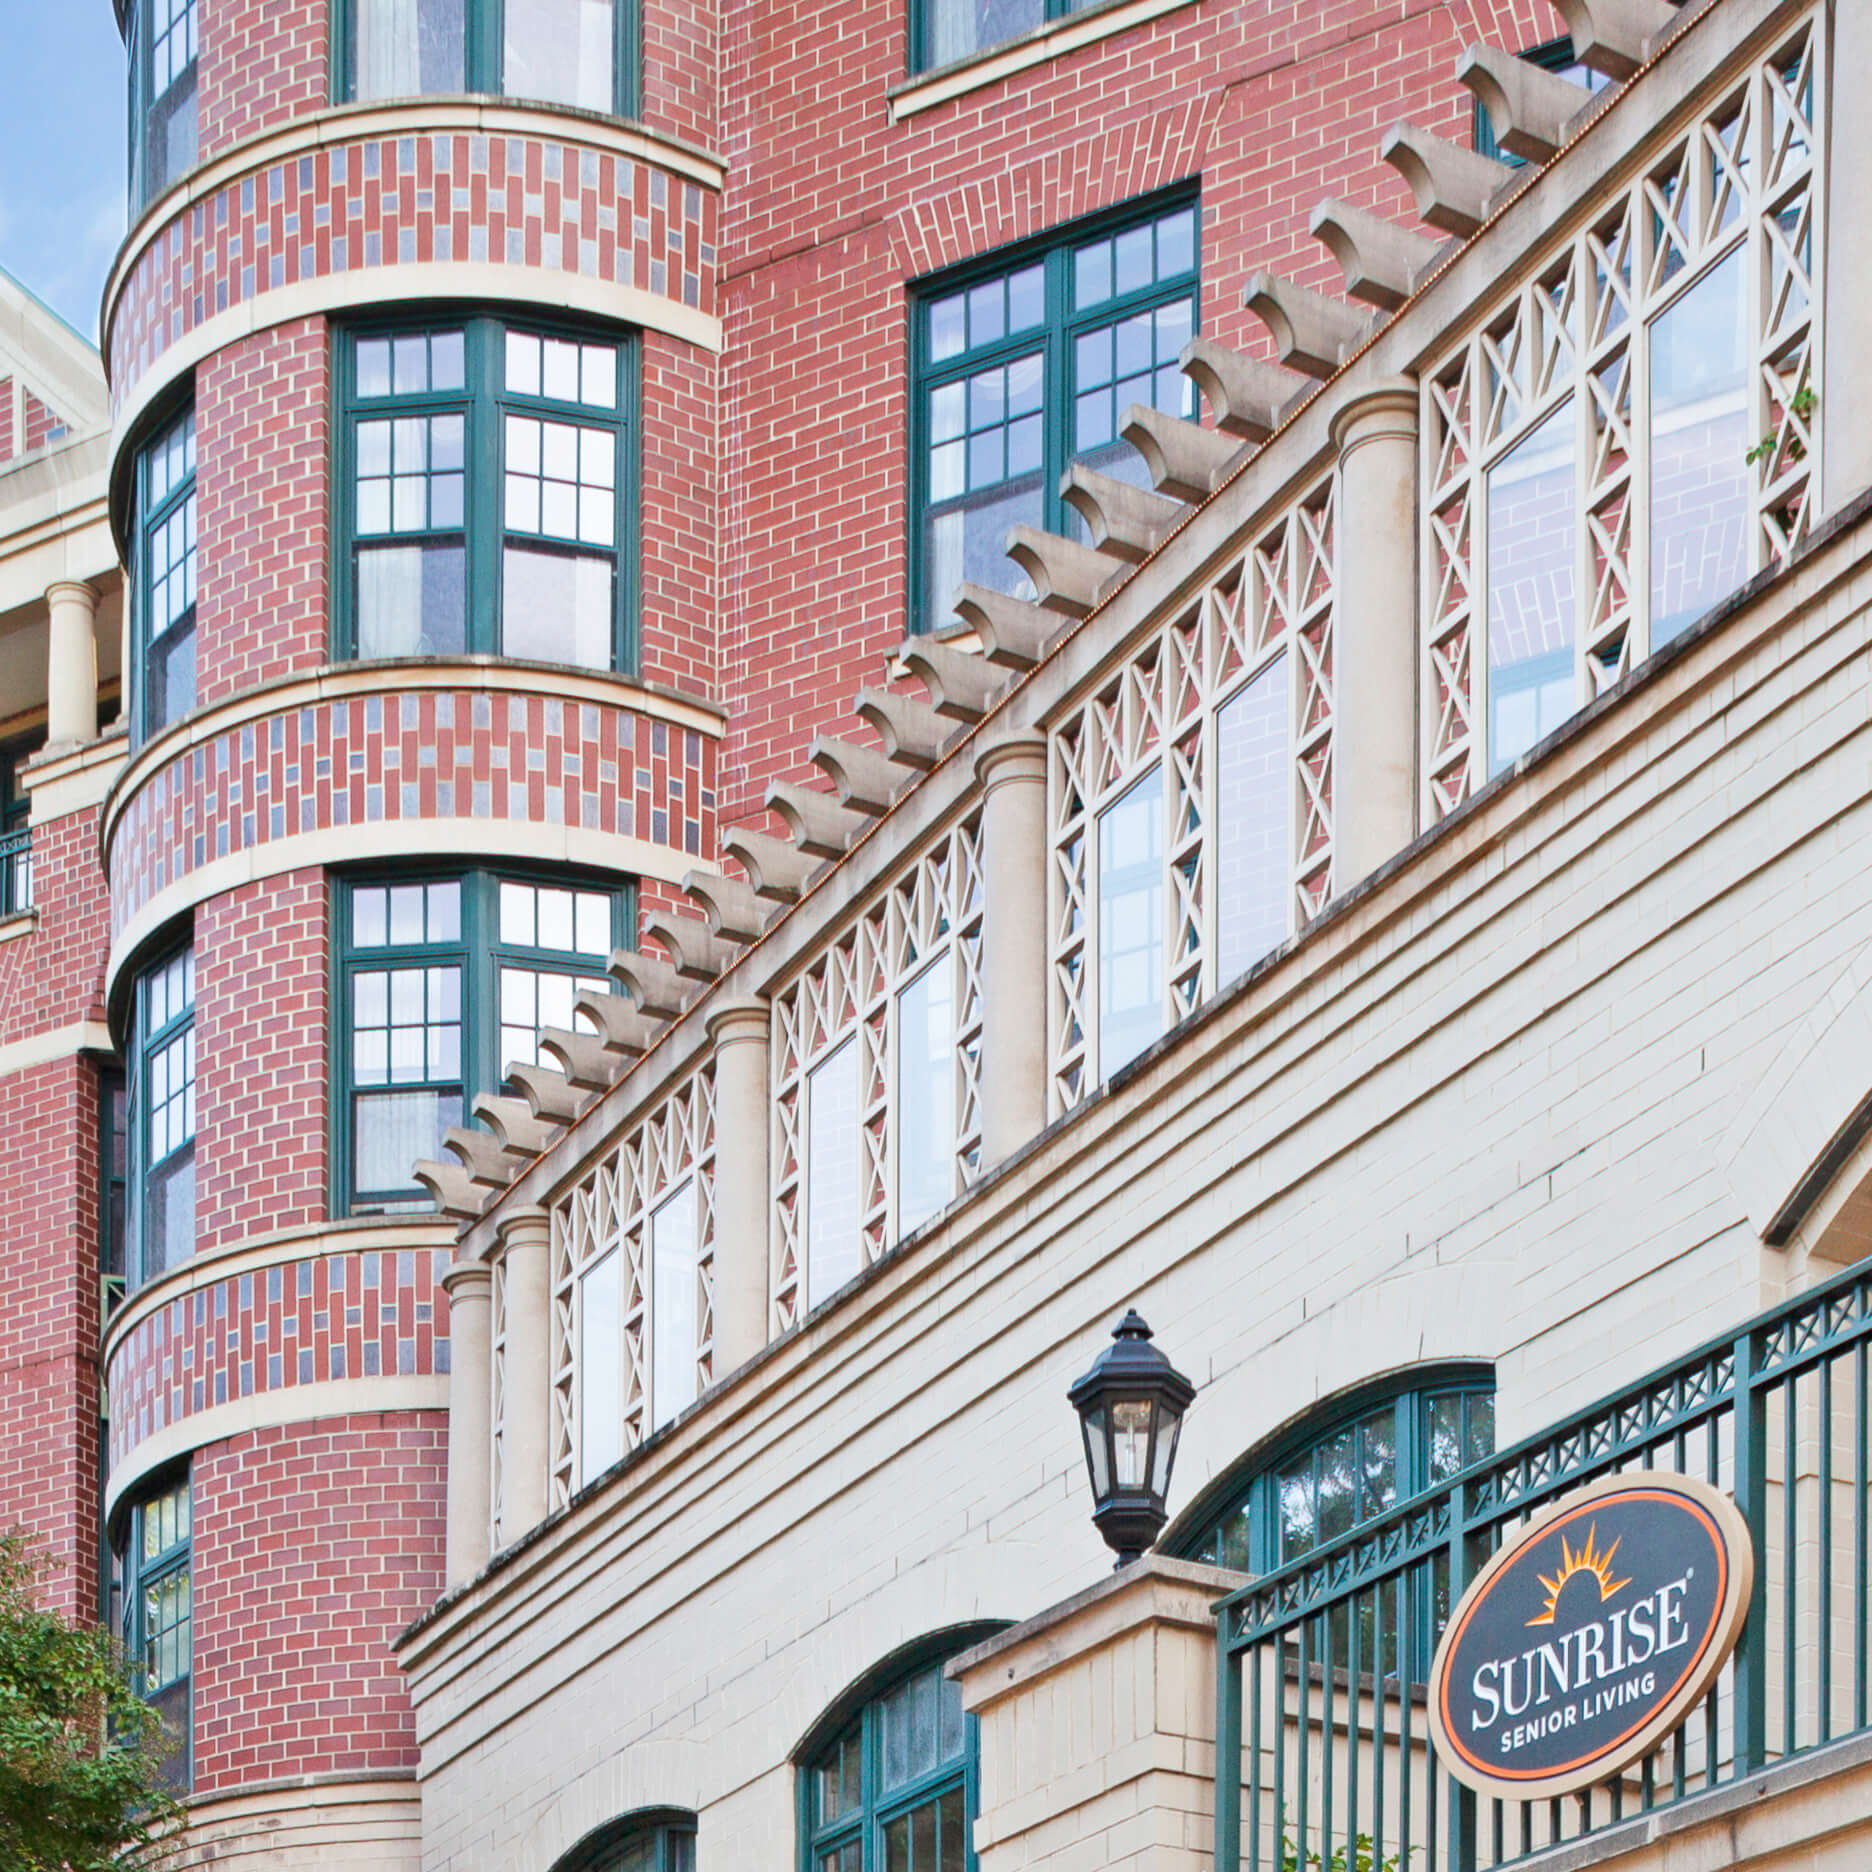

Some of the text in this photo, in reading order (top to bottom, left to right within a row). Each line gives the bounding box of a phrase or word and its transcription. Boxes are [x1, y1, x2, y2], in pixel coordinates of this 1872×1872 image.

[1472, 1577, 1688, 1731] SUNRISE
[1500, 1672, 1655, 1752] SENIOR LIVING
